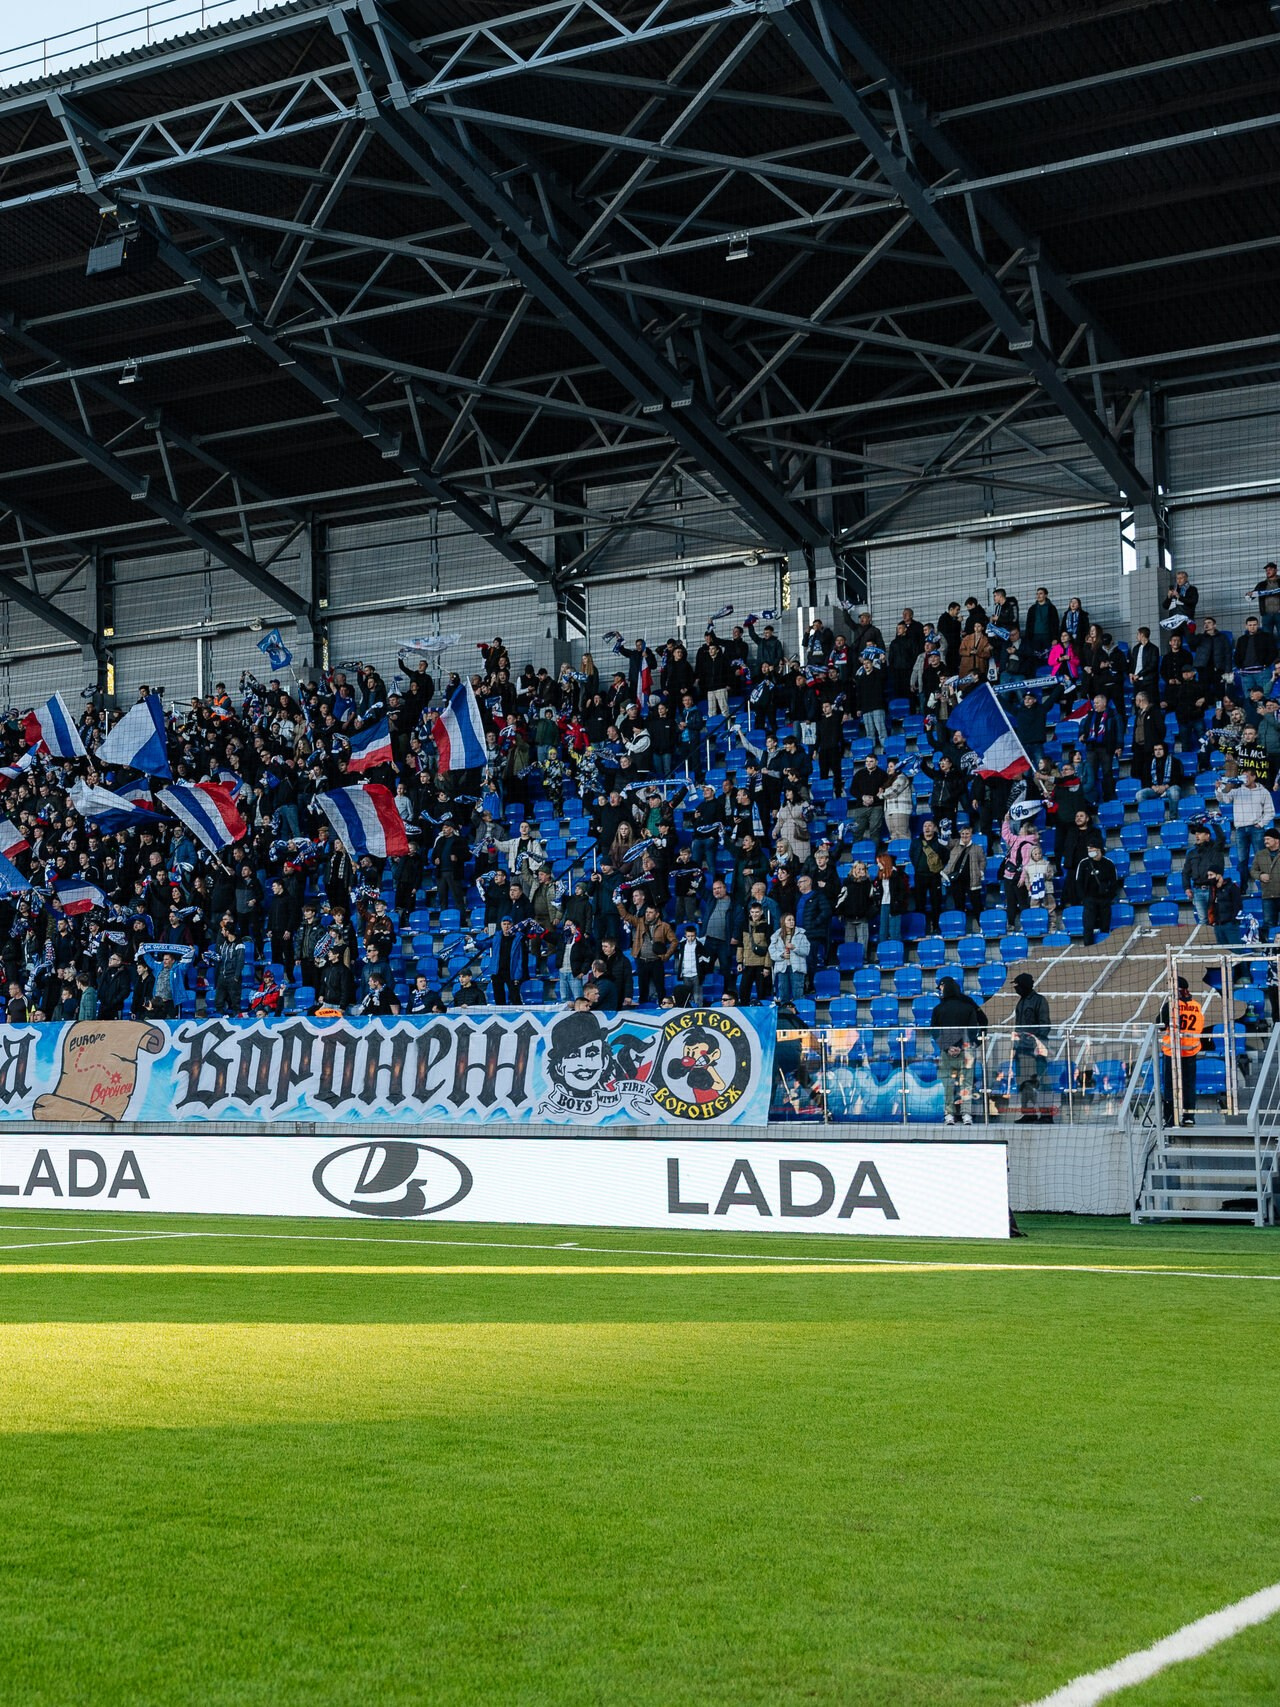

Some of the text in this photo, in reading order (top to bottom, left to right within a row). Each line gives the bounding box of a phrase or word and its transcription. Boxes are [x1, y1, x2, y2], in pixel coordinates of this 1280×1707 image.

[1179, 1014, 1197, 1031] 62
[557, 1082, 646, 1112] BOYS WITH FIRE
[654, 1085, 742, 1118] ВОРОНЕЖ
[667, 1157, 900, 1221] LADA
